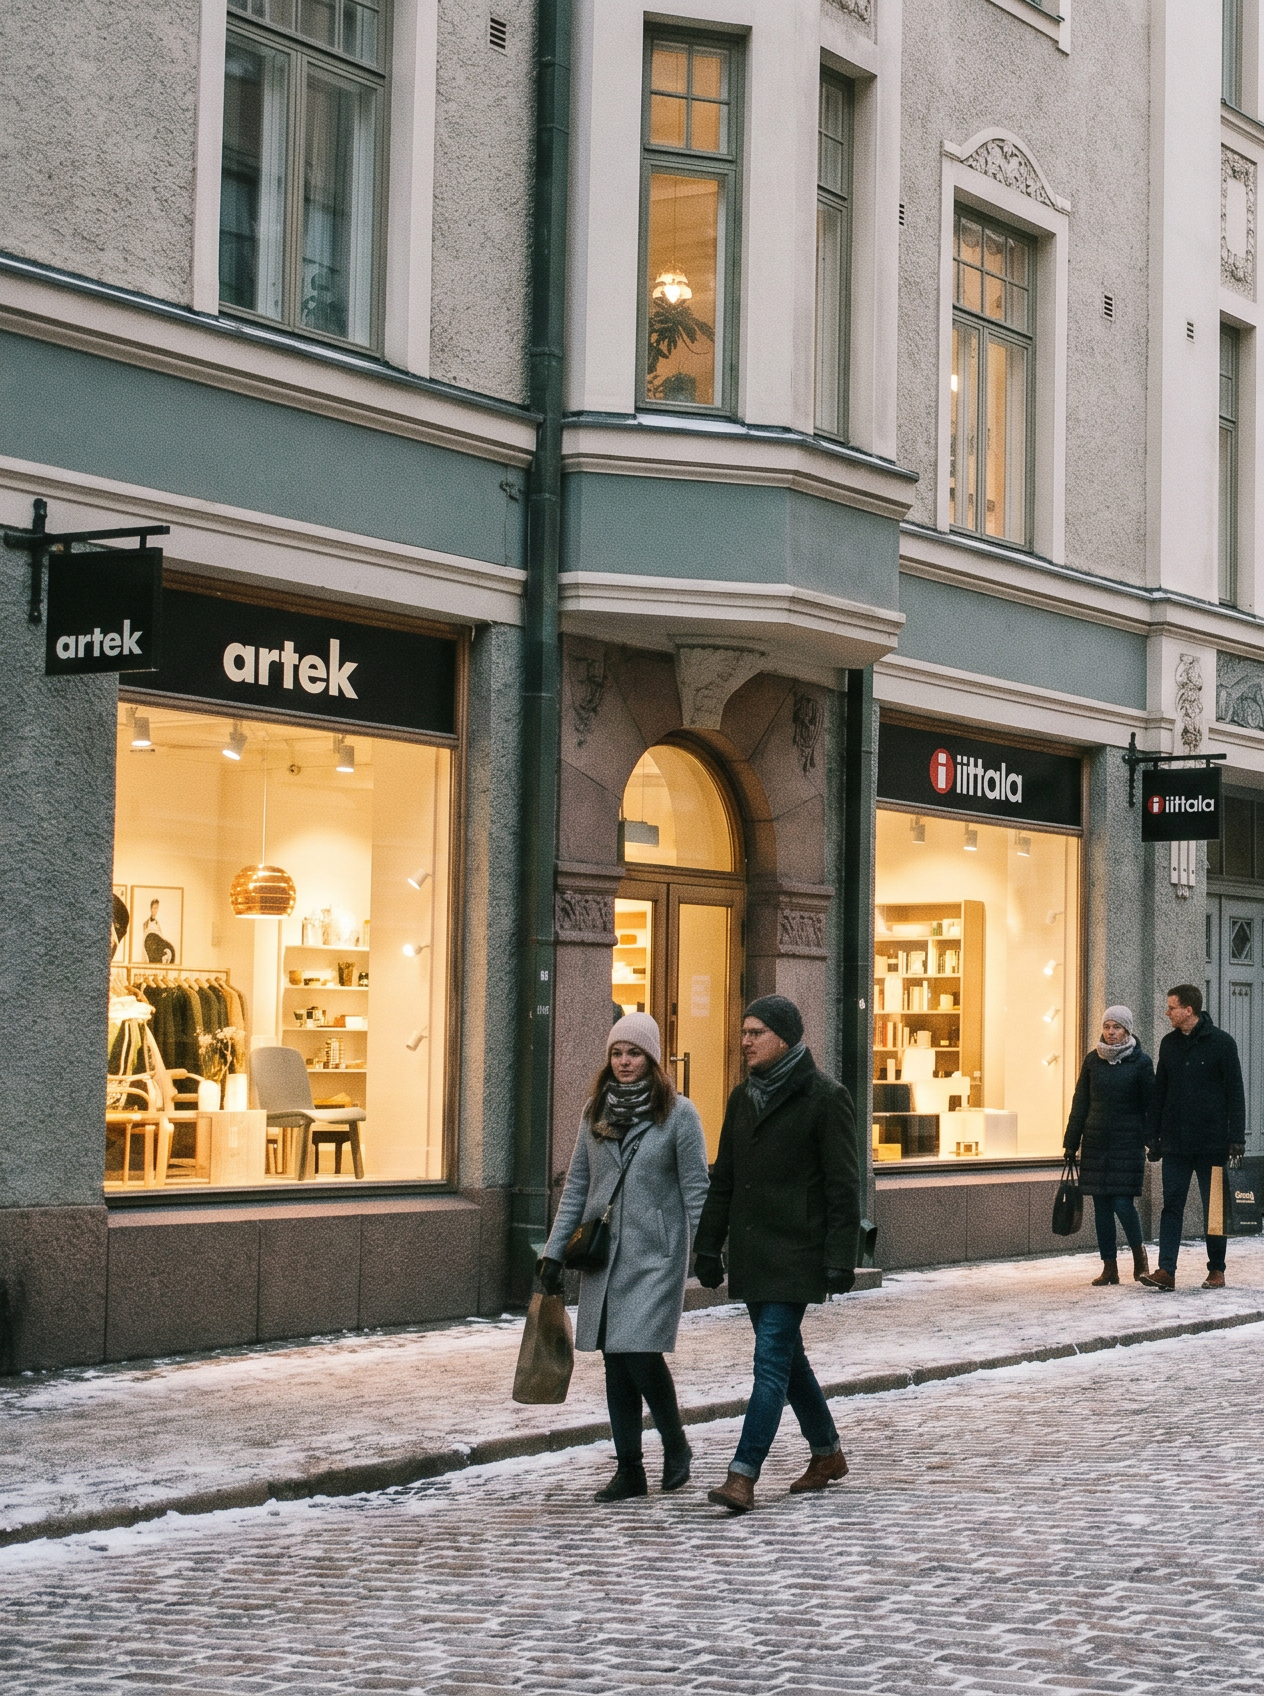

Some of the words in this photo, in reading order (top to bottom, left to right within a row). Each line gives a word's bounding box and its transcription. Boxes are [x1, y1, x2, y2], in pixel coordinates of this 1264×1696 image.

[56, 619, 143, 660] artek
[223, 638, 359, 700] artek
[956, 754, 1023, 804] iittala
[1165, 795, 1215, 813] iittala
